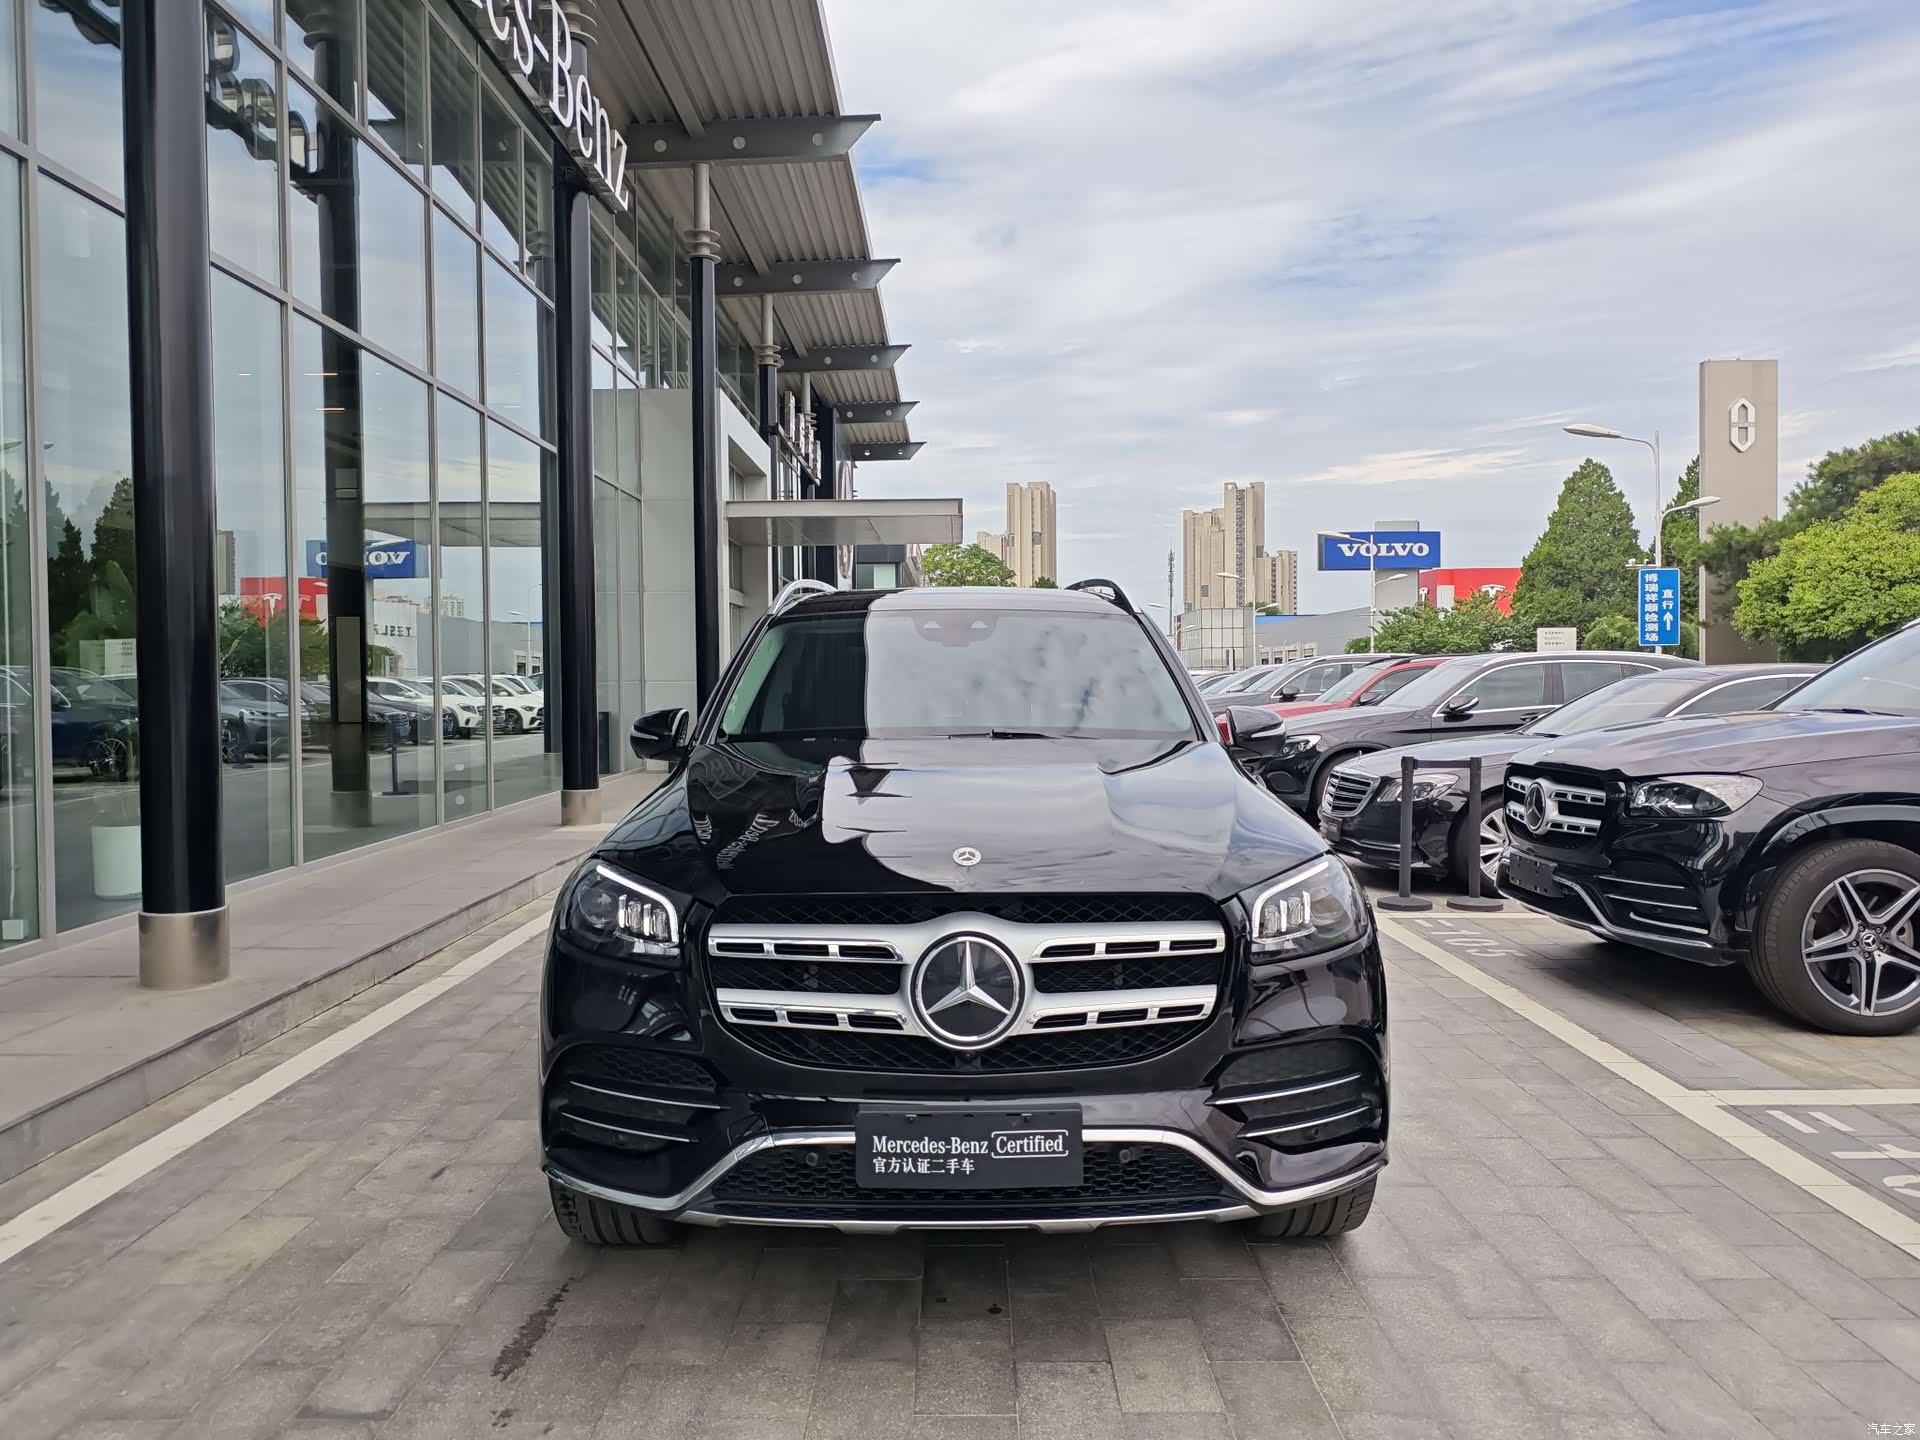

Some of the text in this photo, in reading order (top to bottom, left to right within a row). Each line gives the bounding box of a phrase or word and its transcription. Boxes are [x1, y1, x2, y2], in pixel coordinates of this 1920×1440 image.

[473, 0, 628, 211] s-Benz
[1337, 543, 1429, 556] VOLVO
[1662, 588, 1674, 609] 直行
[872, 1134, 1063, 1154] Mercedes-Benz Certified
[873, 1157, 975, 1174] 官方认证二手车
